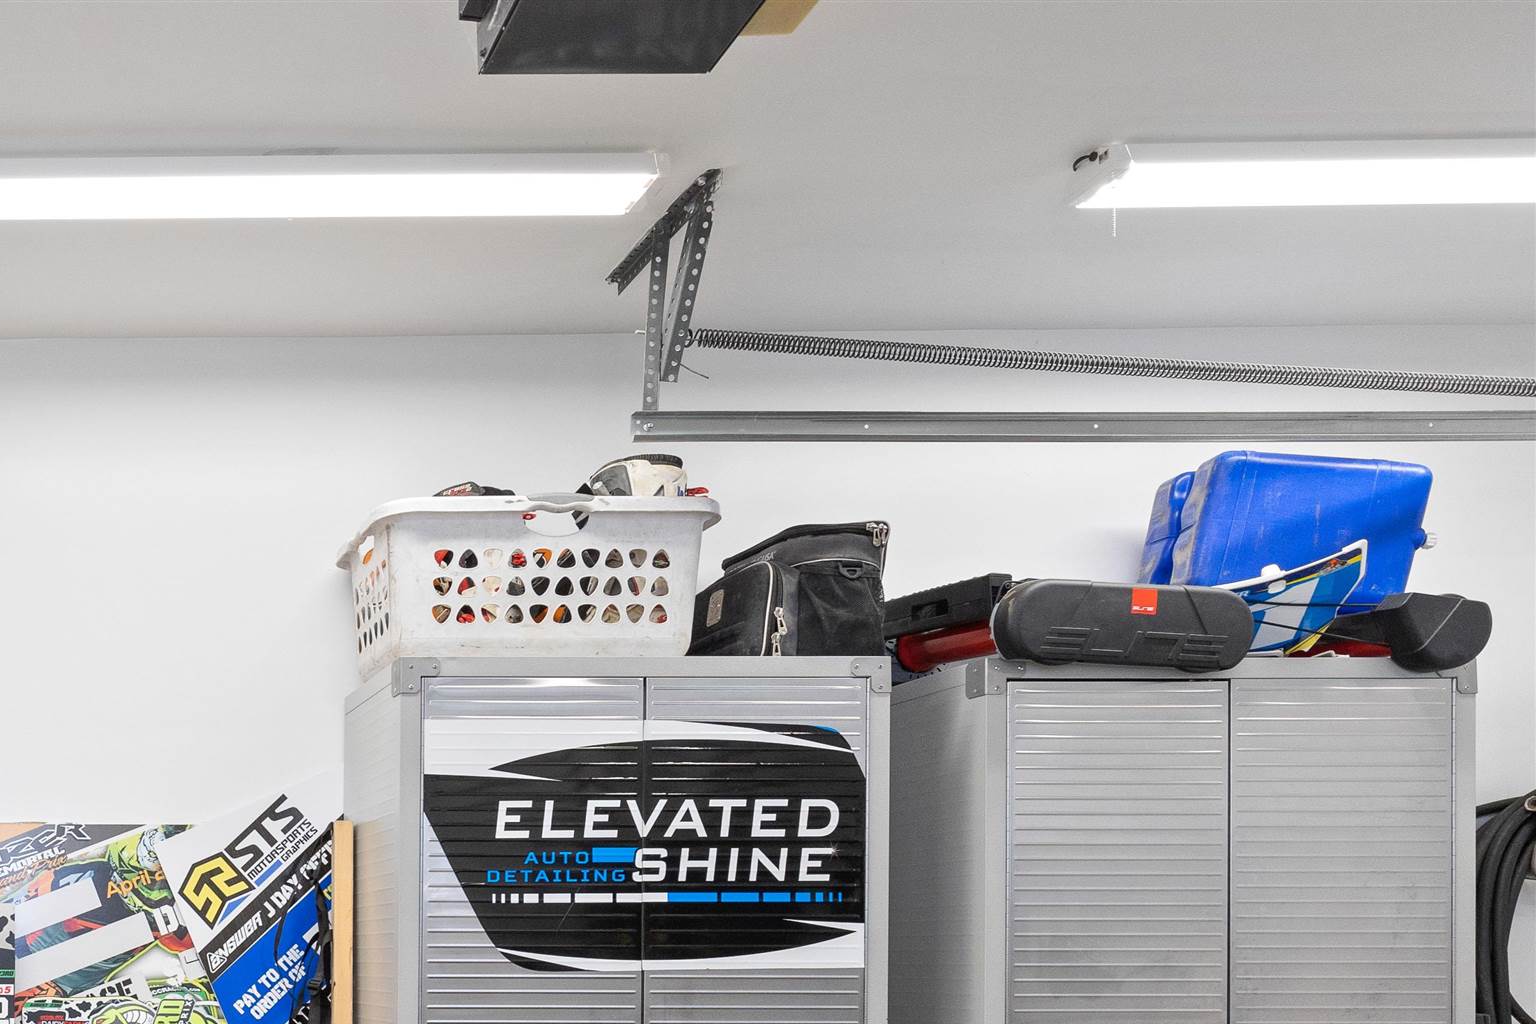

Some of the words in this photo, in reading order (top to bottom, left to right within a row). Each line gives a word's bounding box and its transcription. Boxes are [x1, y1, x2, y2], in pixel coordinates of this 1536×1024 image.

[224, 794, 304, 873] STS
[495, 799, 840, 839] ELEVATED
[247, 819, 311, 880] MOTORSPORTS
[524, 851, 590, 865] AUTO
[631, 847, 834, 883] SHINE
[107, 869, 152, 898] April
[270, 873, 303, 909] DAY
[487, 869, 626, 883] DETAILING
[4, 985, 12, 994] 5
[233, 984, 262, 1015] PAY
[258, 967, 281, 989] TO
[276, 943, 306, 973] THE
[250, 977, 293, 1020] ORDER
